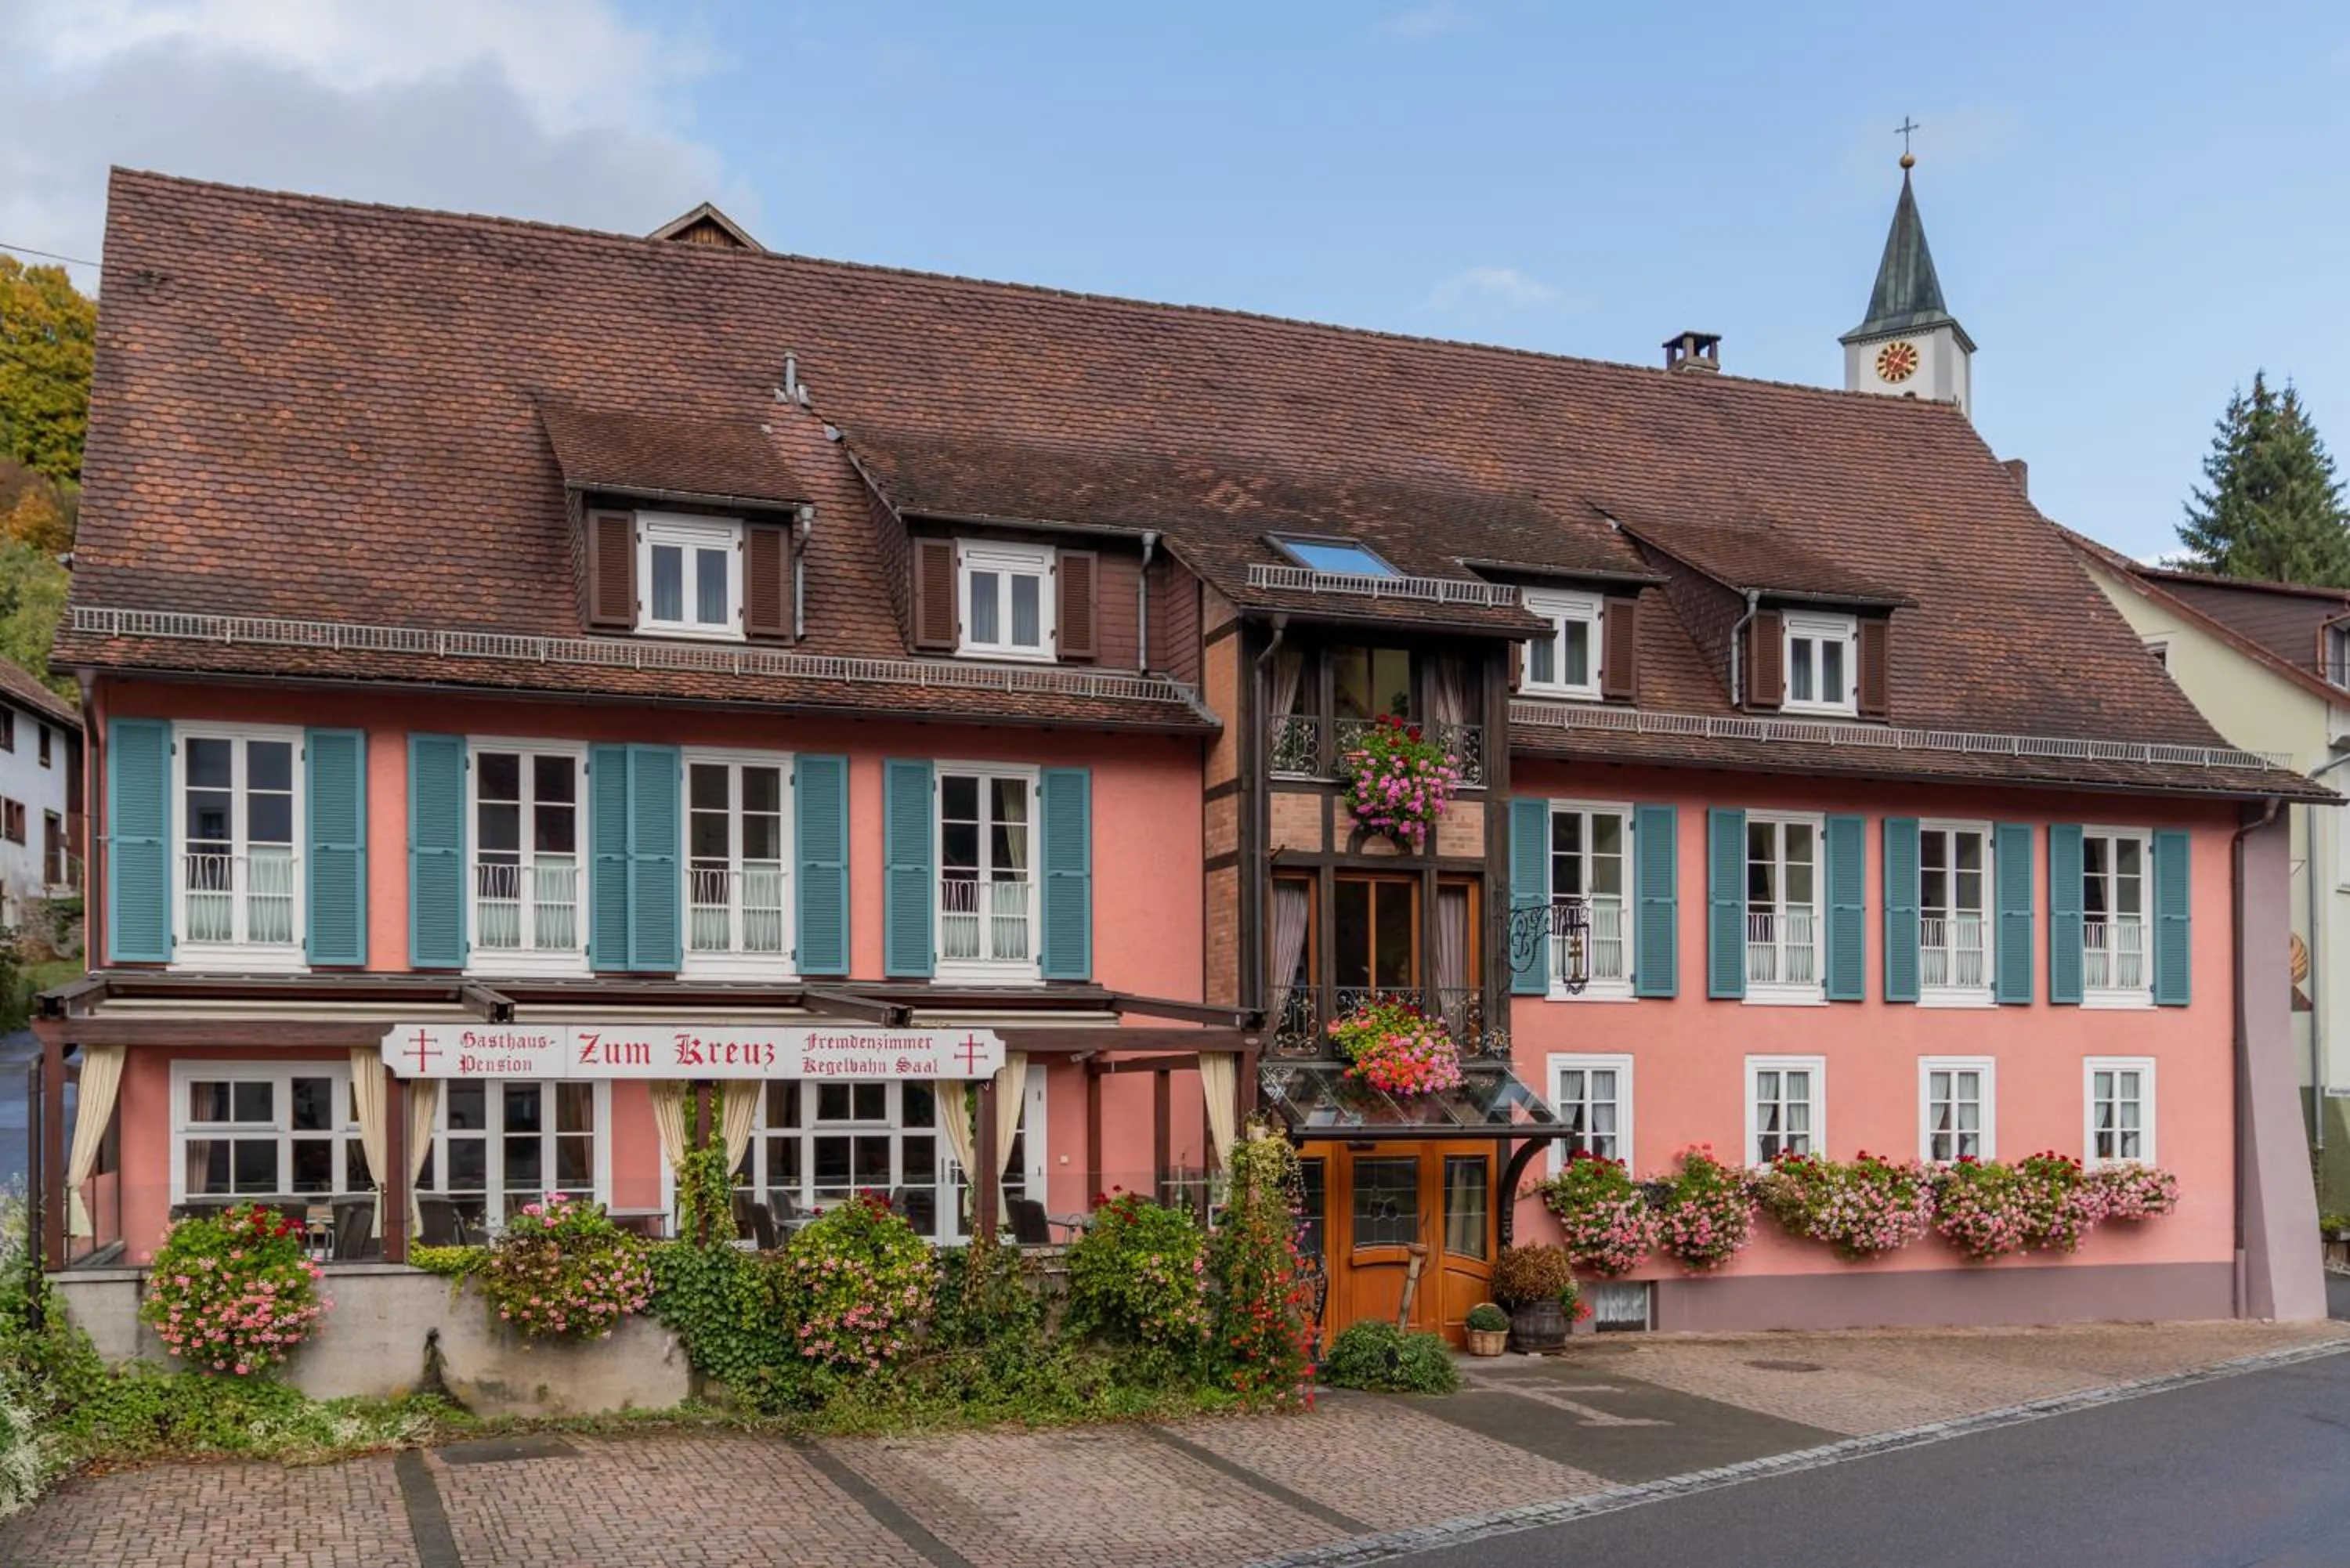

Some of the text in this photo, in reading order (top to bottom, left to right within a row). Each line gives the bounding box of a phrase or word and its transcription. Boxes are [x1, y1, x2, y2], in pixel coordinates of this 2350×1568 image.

[460, 1031, 556, 1050] Gasthaus-
[801, 1033, 933, 1053] Fremdenzimmer
[578, 1033, 776, 1071] Zum Kreuz
[458, 1054, 532, 1074] Pension
[801, 1057, 938, 1075] Kegelbahn Saal
